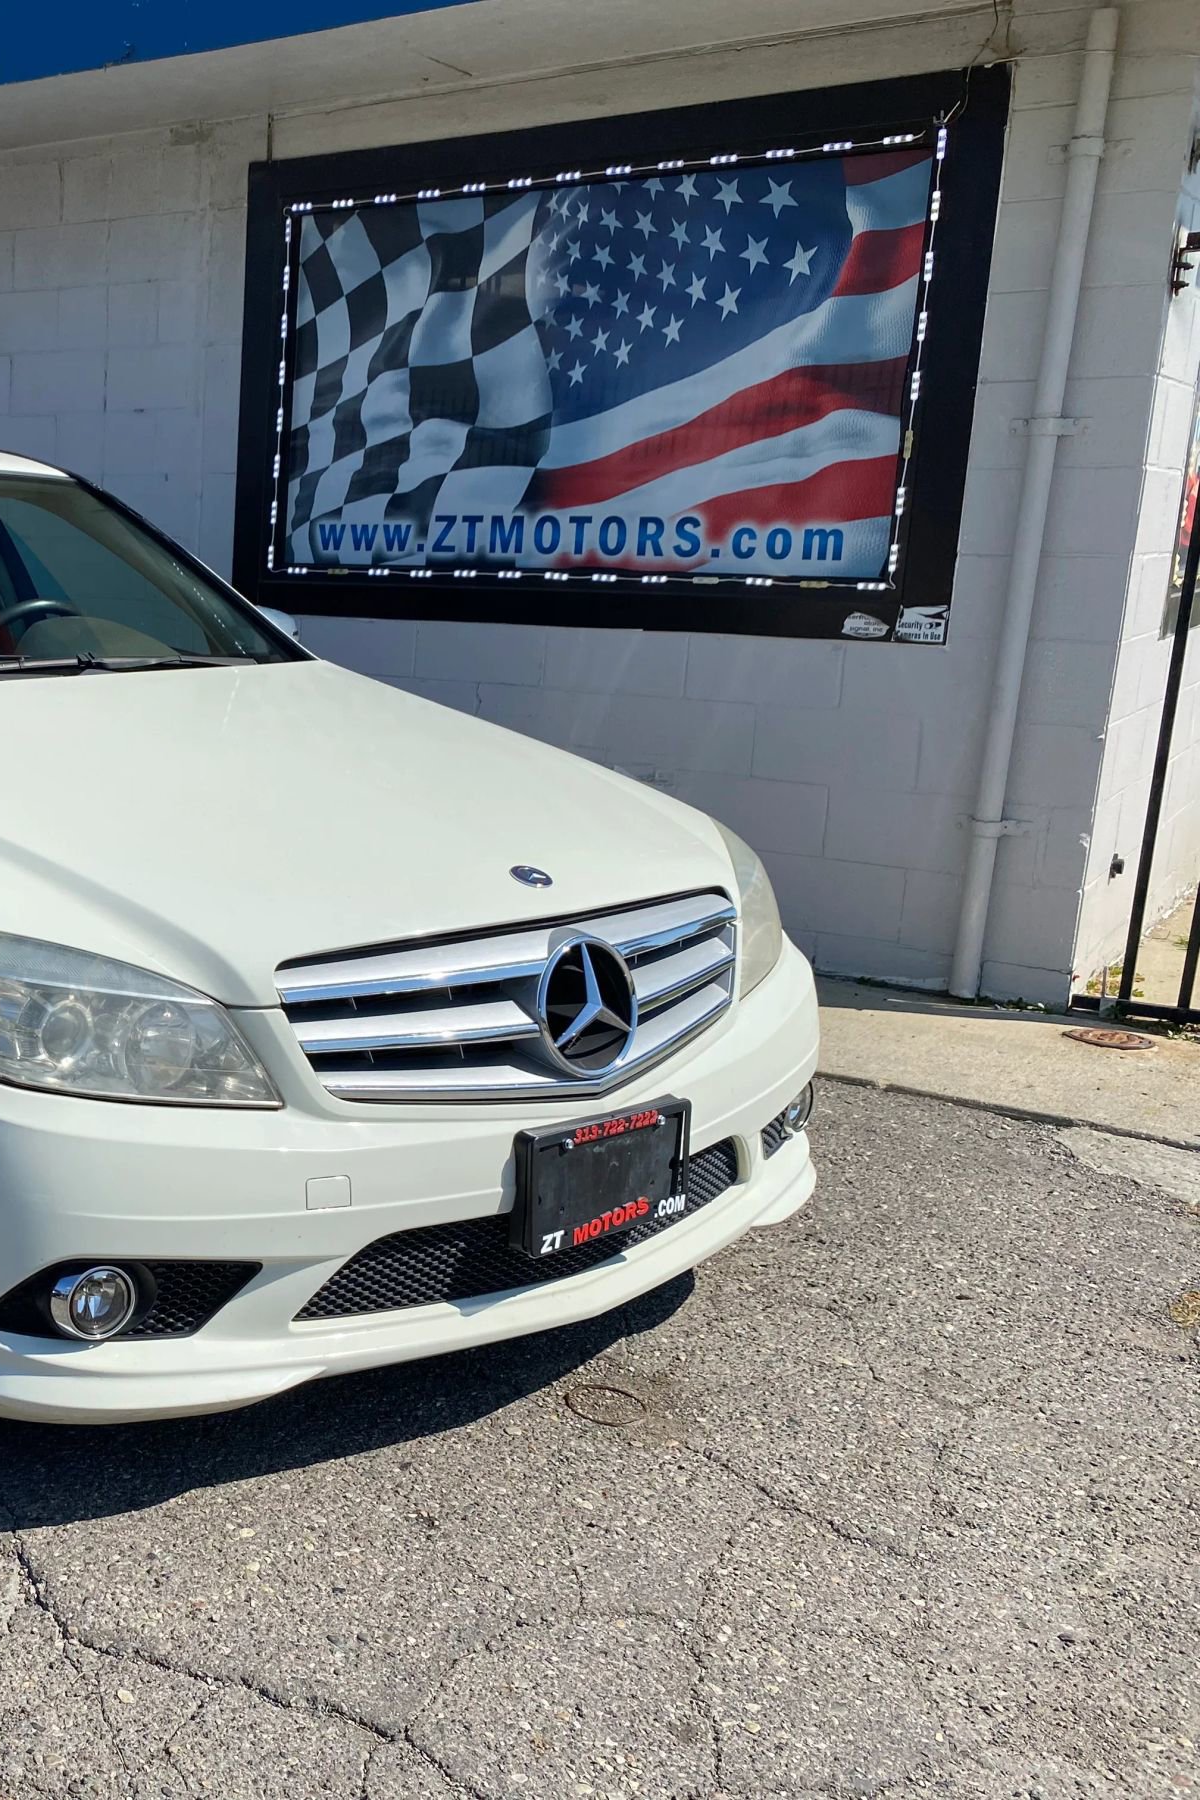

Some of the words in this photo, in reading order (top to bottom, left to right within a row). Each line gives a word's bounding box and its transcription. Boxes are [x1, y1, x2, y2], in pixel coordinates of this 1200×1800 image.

[318, 514, 845, 562] www.ZTMOTORS.com
[930, 632, 941, 641] Use
[573, 1109, 658, 1144] 313-722-7222
[540, 1229, 565, 1254] ZT
[573, 1196, 650, 1246] MOTORS
